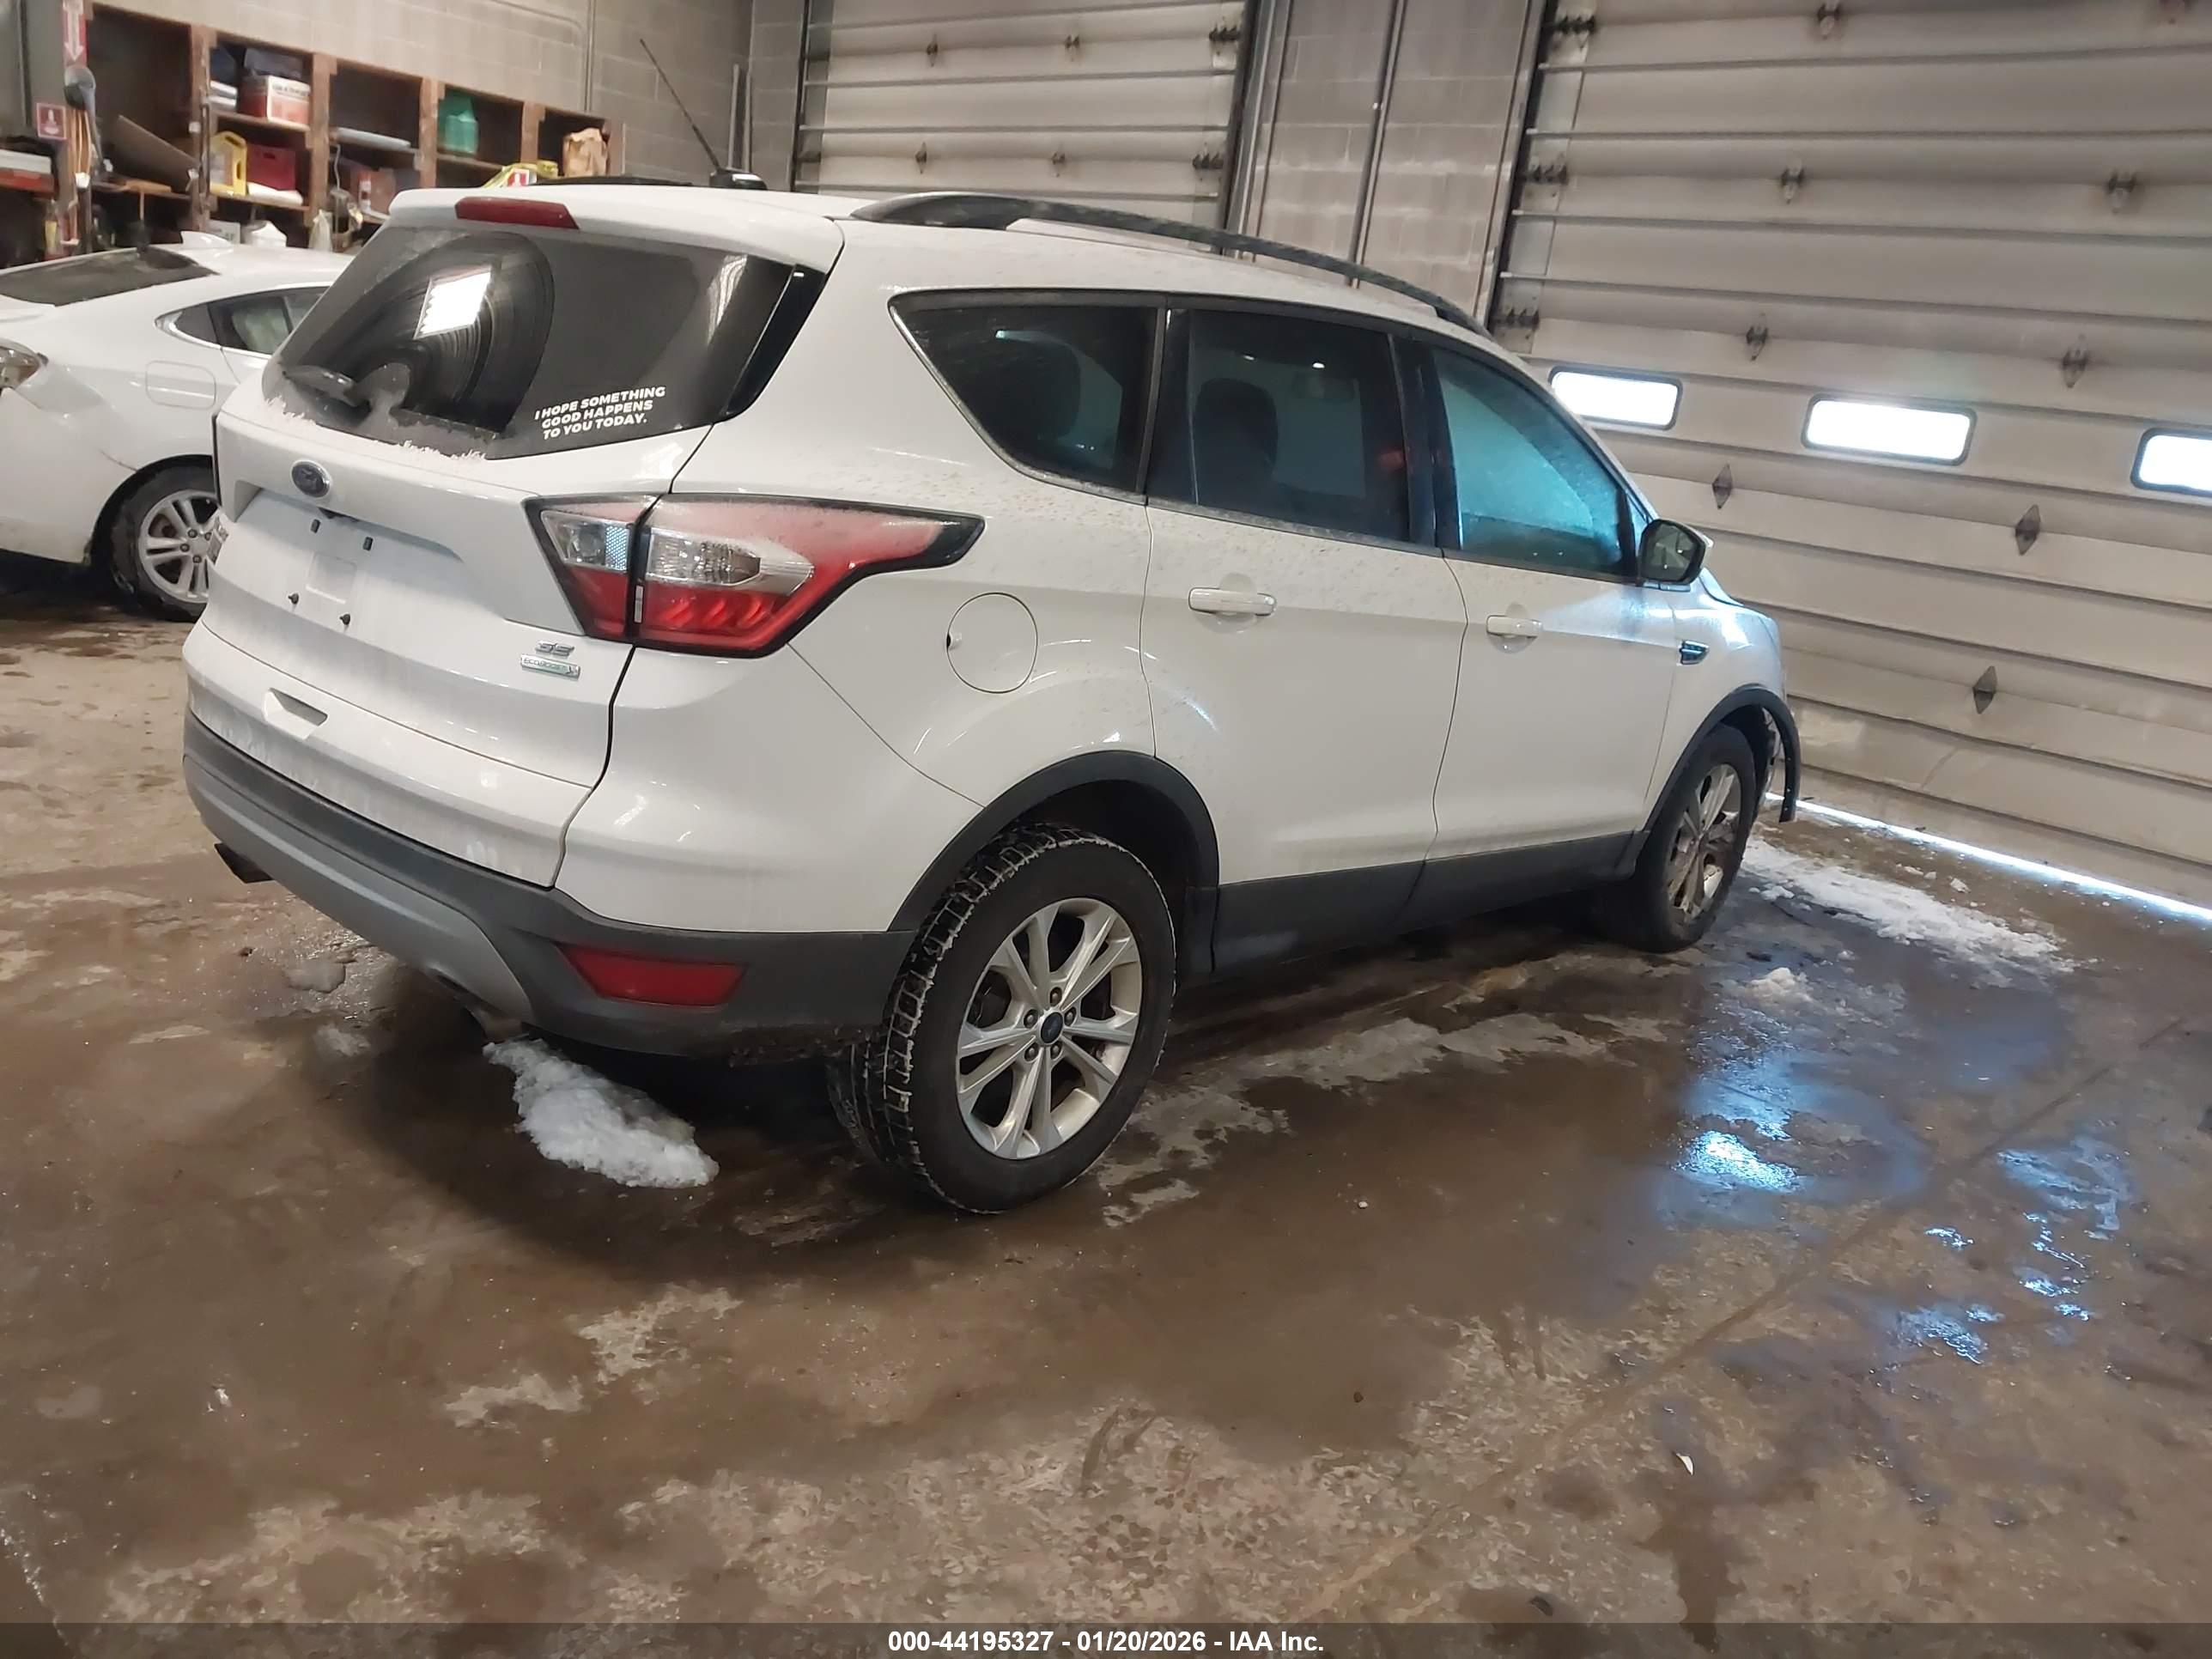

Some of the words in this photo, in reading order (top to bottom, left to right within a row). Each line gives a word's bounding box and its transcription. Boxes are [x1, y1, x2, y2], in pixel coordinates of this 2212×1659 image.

[535, 410, 540, 420] I
[541, 401, 579, 418] HOPE
[580, 386, 665, 410] SOMETHING
[542, 412, 581, 428] GOOD
[584, 400, 653, 420] HAPPENS
[543, 428, 561, 440] TO
[563, 421, 592, 435] YOU
[596, 413, 647, 429] TODAY.
